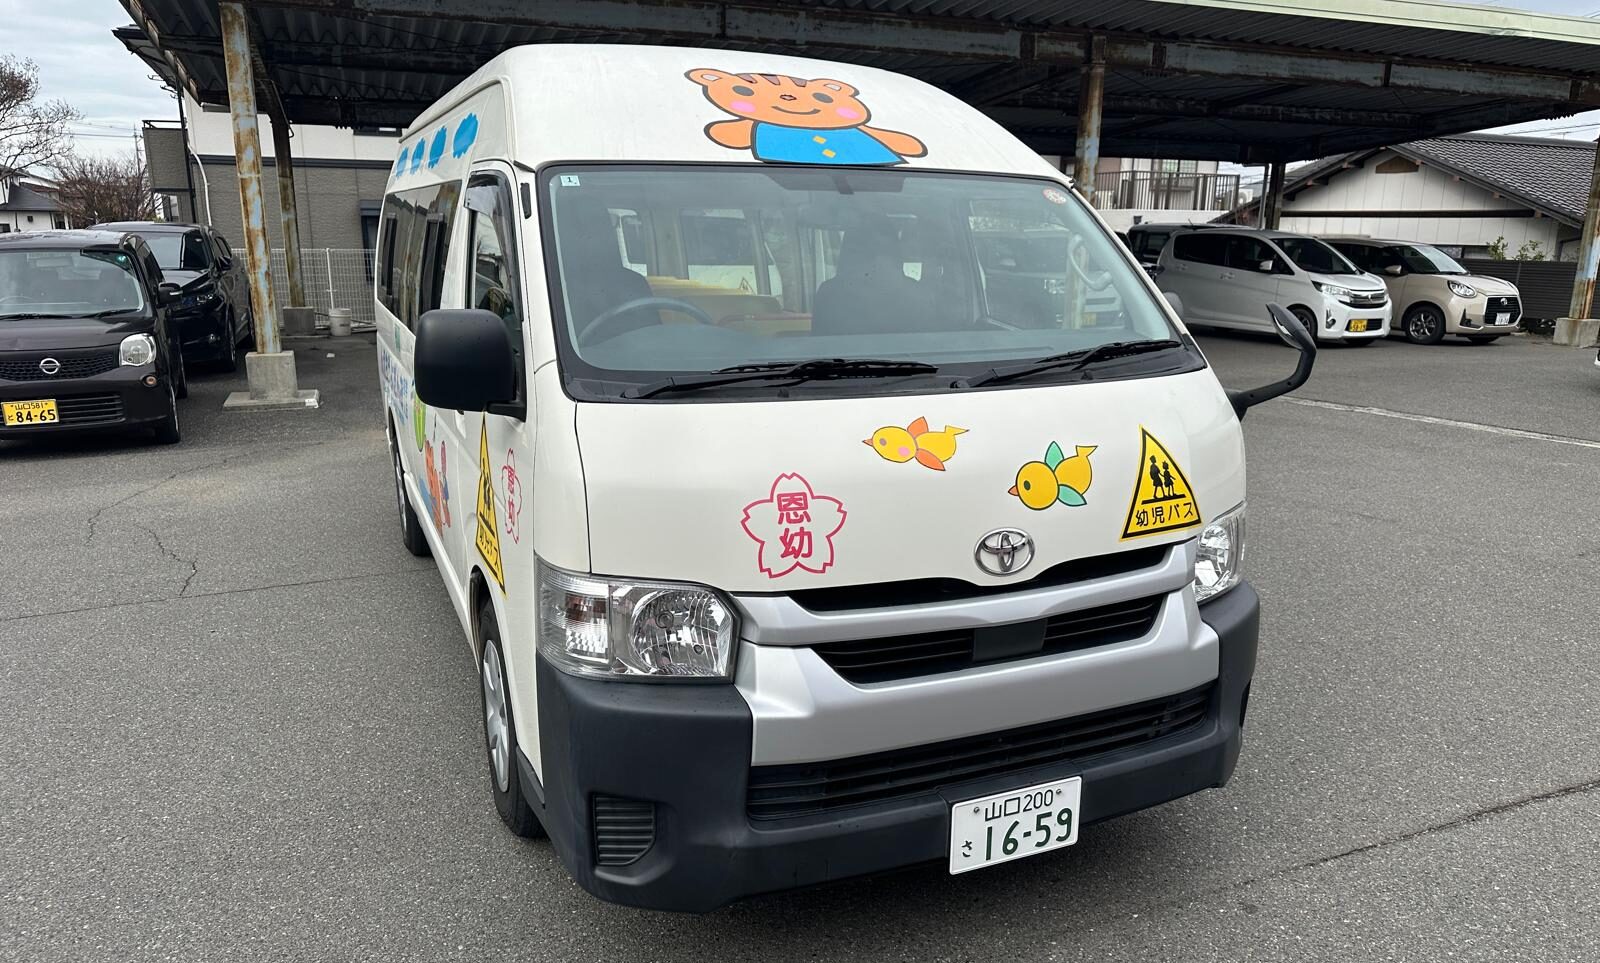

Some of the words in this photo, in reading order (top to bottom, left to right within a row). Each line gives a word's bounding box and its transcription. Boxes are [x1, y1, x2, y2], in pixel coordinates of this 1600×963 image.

[16, 409, 56, 423] 84-65
[777, 492, 812, 559] 恩幼
[1136, 502, 1194, 527] 幼児バス
[985, 789, 1054, 822] 山口200
[961, 840, 973, 858] さ
[985, 807, 1073, 861] 16-59
